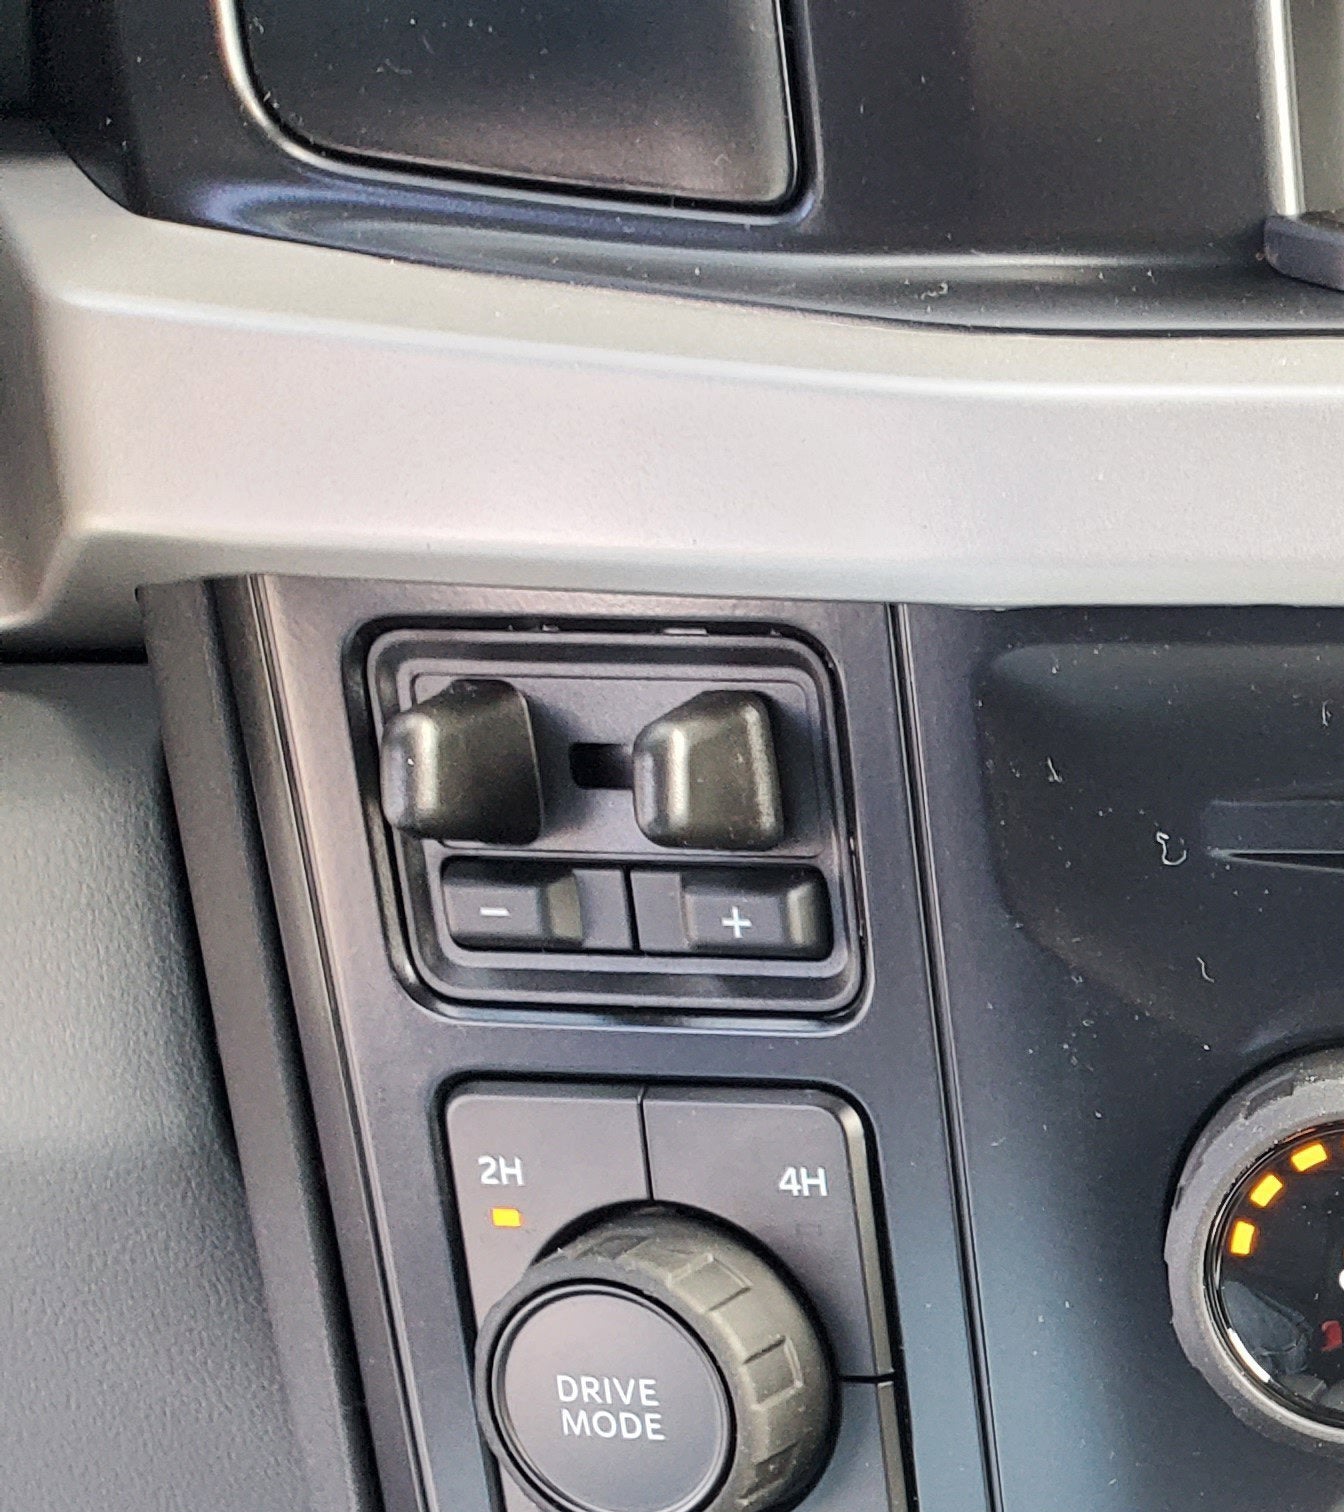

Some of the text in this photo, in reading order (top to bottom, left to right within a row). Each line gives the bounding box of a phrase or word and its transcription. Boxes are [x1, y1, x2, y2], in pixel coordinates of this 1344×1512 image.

[478, 1155, 524, 1186] 2H
[778, 1166, 828, 1197] 4H
[556, 1374, 660, 1406] DRIVE
[561, 1409, 666, 1441] MODE
